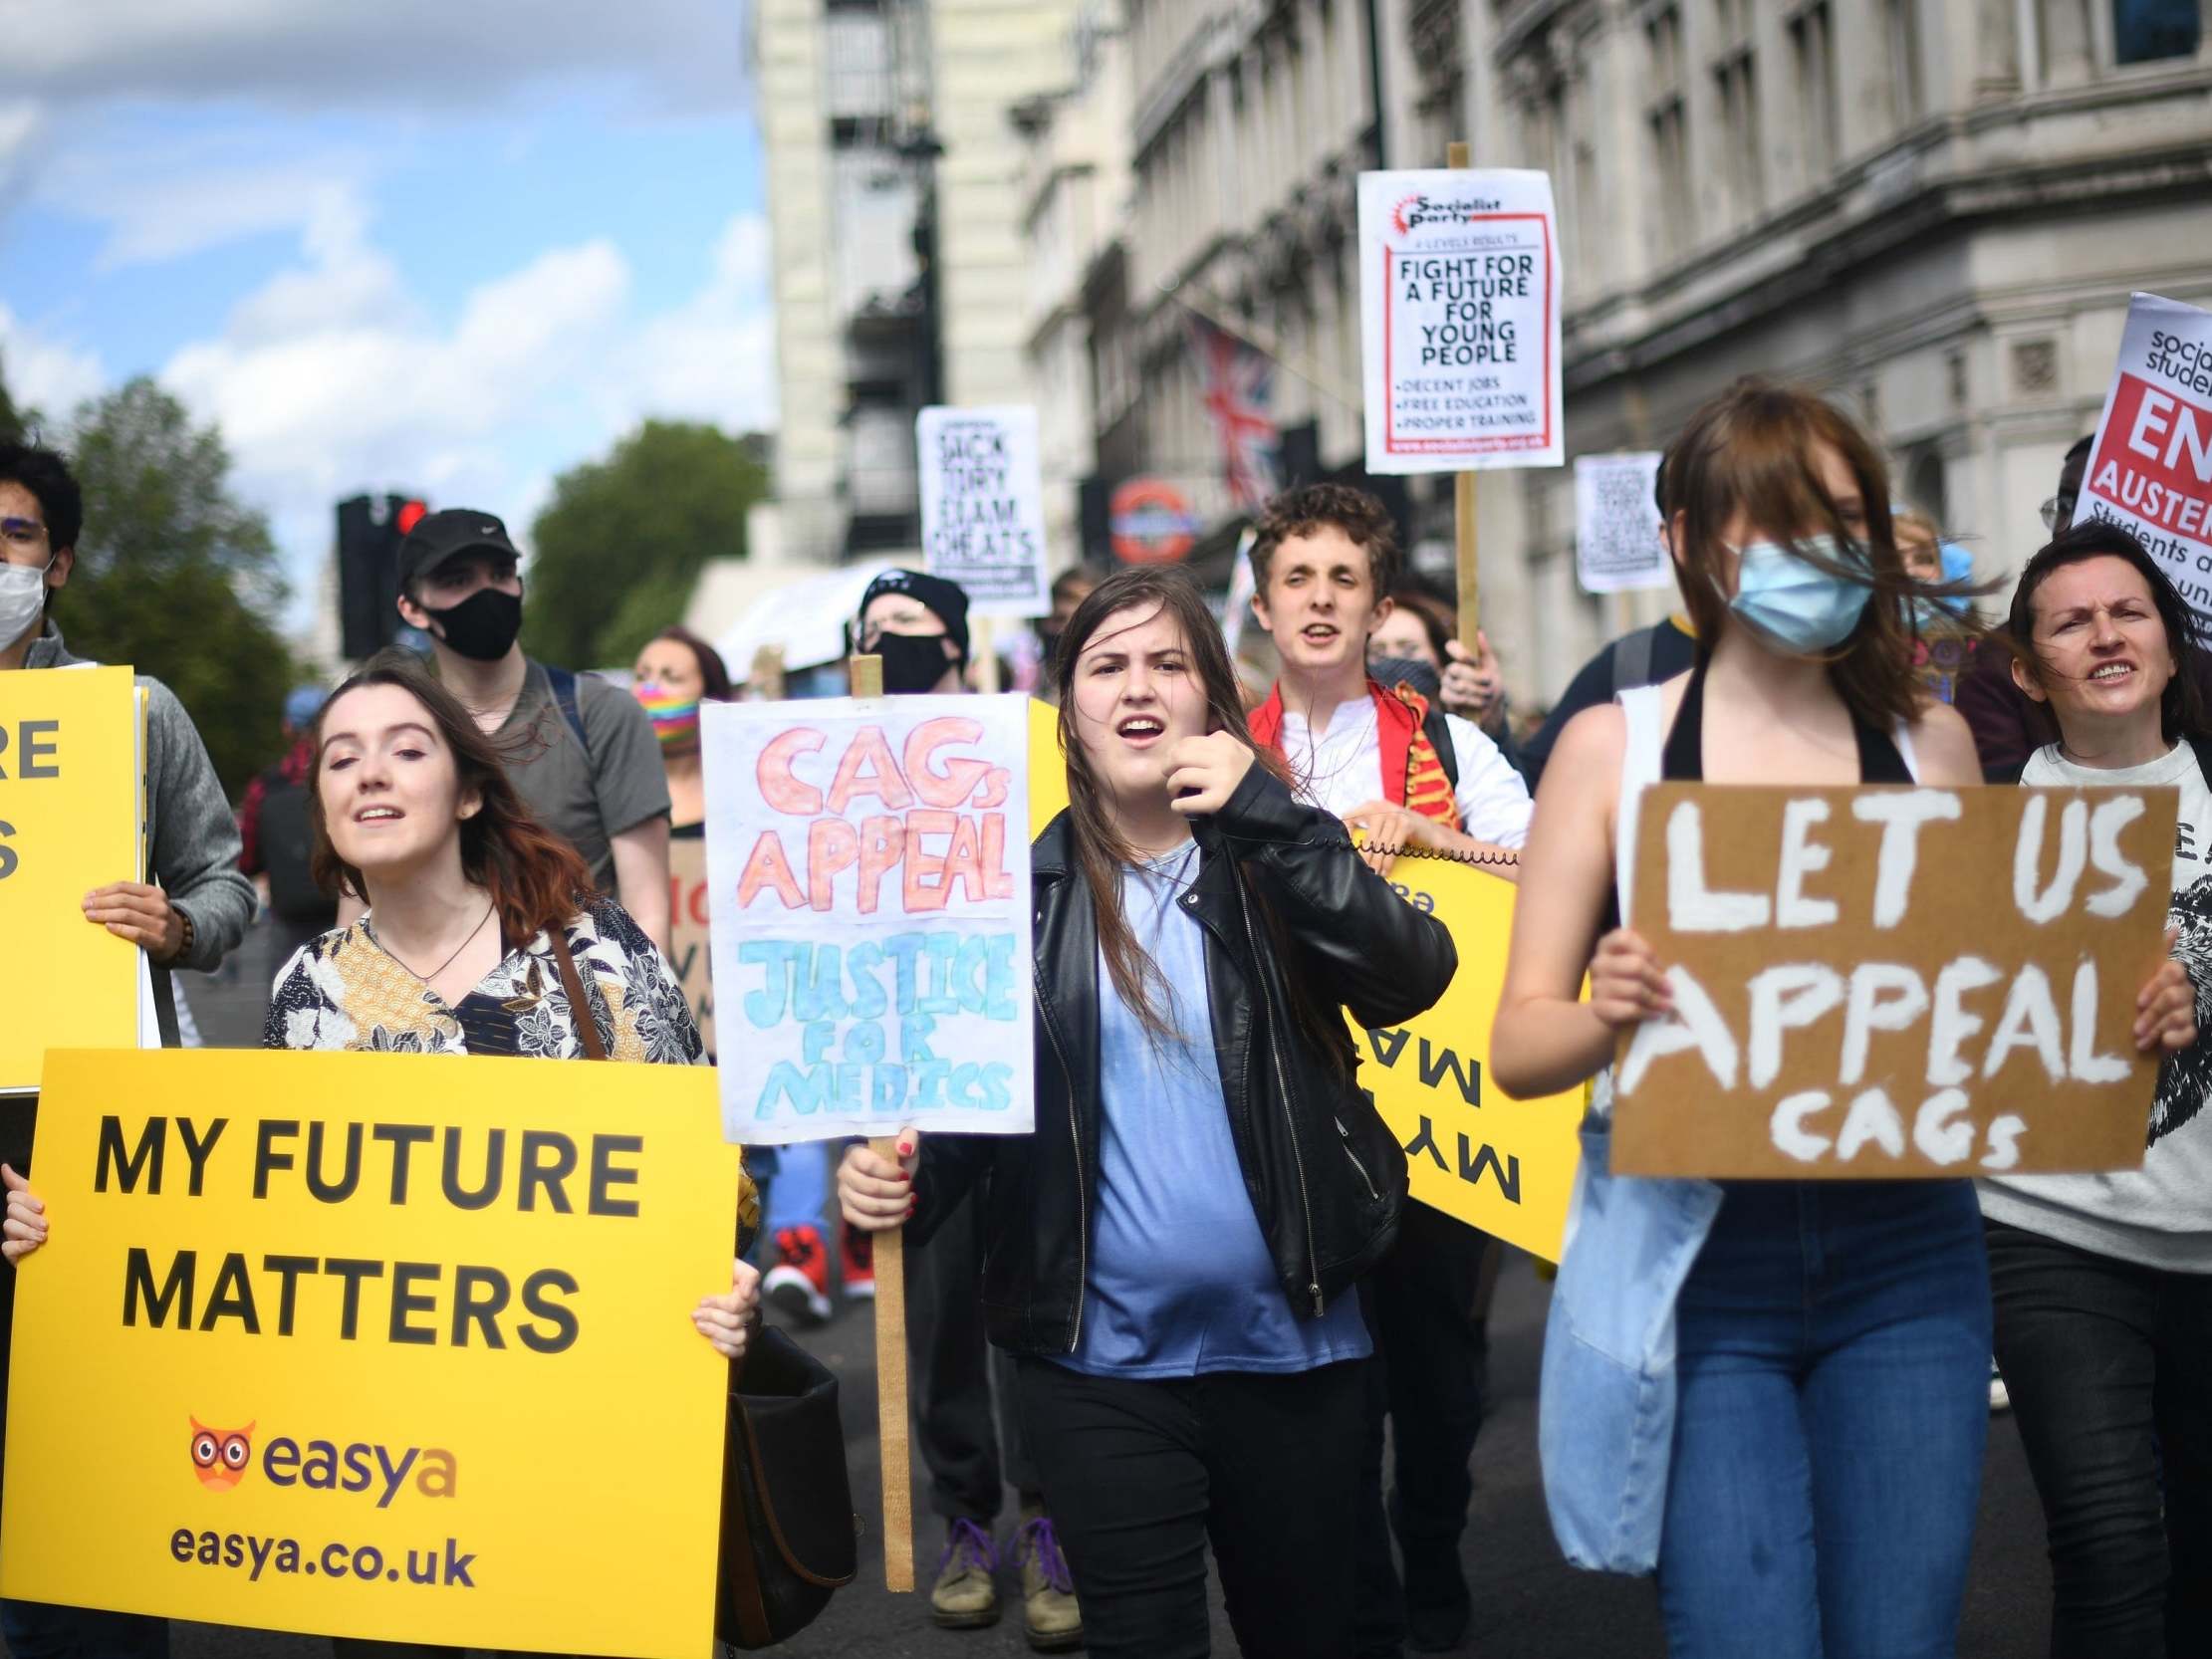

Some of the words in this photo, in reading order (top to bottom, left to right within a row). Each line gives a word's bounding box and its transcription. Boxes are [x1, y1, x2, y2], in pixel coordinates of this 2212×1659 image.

[1417, 196, 1500, 212] Socialist
[1401, 258, 1477, 280] FIGHT
[1485, 255, 1533, 276] FOR
[1405, 283, 1421, 302] A
[1432, 276, 1529, 301] FUTURE
[1421, 321, 1516, 344] YOUNG
[1446, 301, 1492, 322] FOR
[1422, 343, 1517, 365] PEOPLE
[1403, 378, 1463, 392] DECENT
[1469, 376, 1500, 392] JOBS
[1403, 397, 1437, 410] FREE
[1445, 394, 1527, 409] EDUCATION
[1404, 416, 1465, 429] PROPER
[1470, 410, 1536, 426] TRAINING
[0, 720, 59, 779] E
[737, 809, 1013, 914] APPEAL
[1667, 790, 1962, 931] LET
[2013, 793, 2148, 924] US
[739, 932, 1016, 1029] JUSTICE
[802, 1014, 936, 1065] FOR
[1617, 953, 2131, 1096] APPEAL
[754, 1058, 1013, 1120] MEDICS
[1354, 1028, 1481, 1108] MA
[94, 1115, 229, 1196] MY
[252, 1119, 643, 1217] FUTURE
[1403, 1114, 1521, 1205] MY
[122, 1248, 580, 1354] MATTERS
[263, 1437, 457, 1509] easya
[169, 1527, 477, 1587] easya.co.uk
